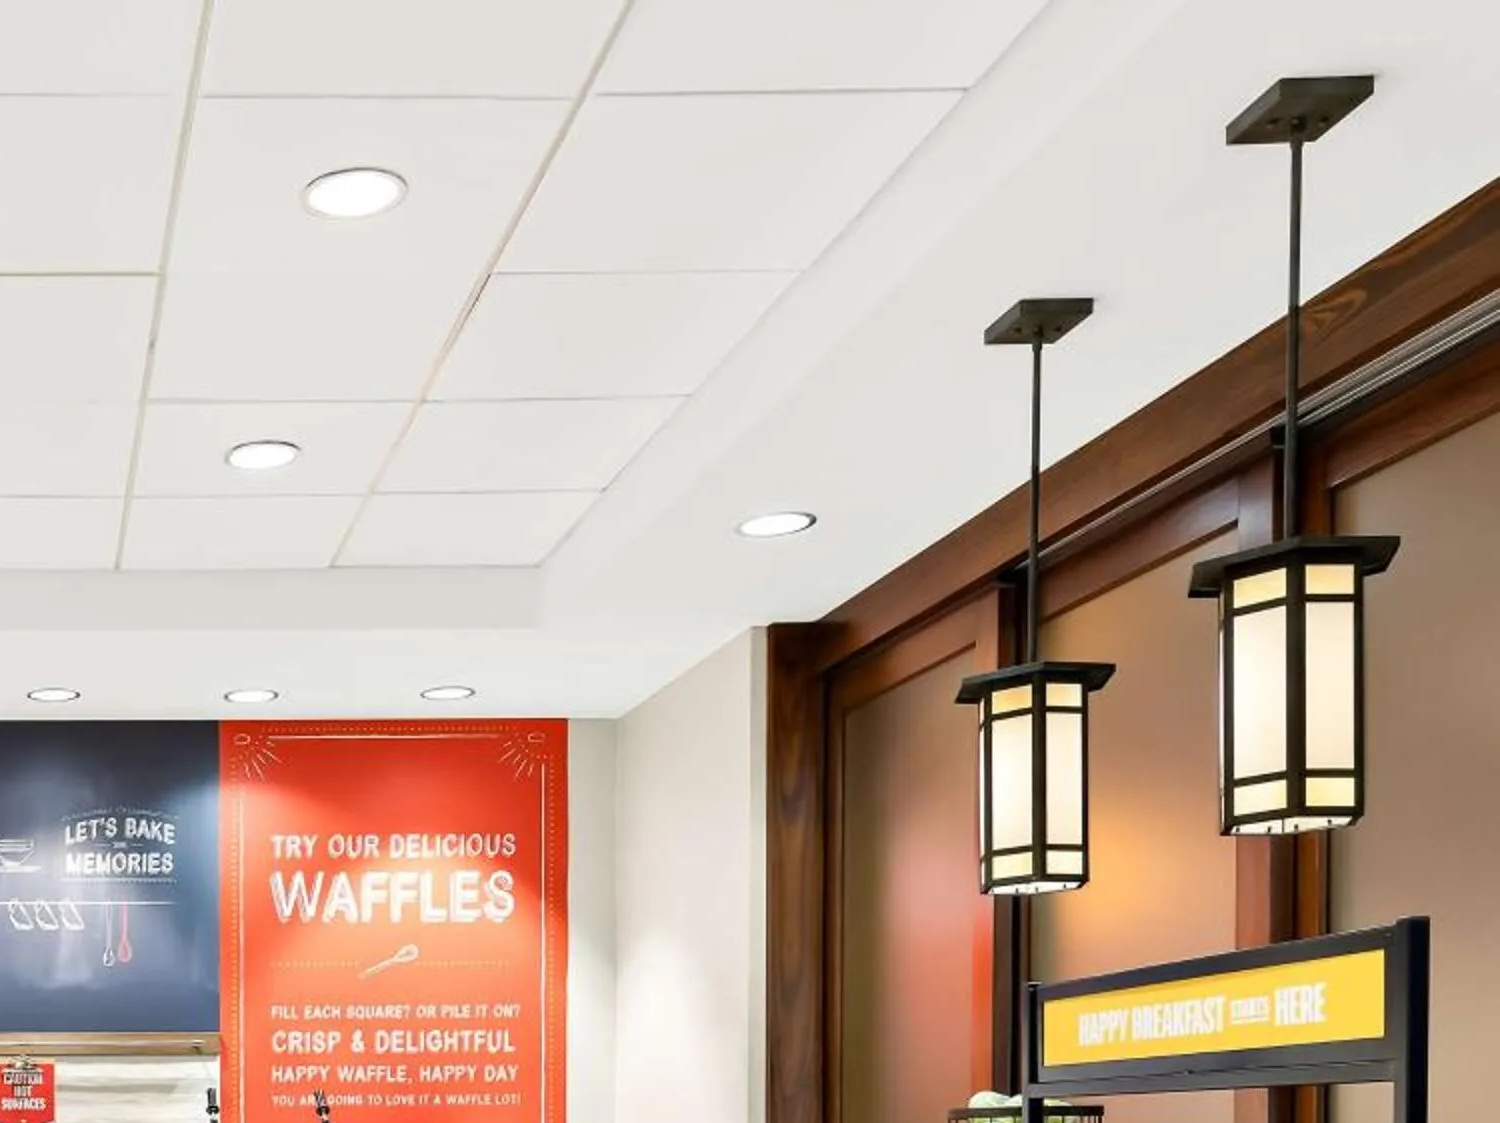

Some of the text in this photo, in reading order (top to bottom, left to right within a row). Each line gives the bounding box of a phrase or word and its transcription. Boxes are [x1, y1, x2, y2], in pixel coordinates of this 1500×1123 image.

[65, 817, 176, 846] LET'S BAKE
[271, 833, 516, 858] TRY OUR DELICIOUS
[65, 852, 174, 876] MEMORIES
[269, 869, 515, 924] WAFFLES
[271, 1003, 521, 1020] FILL EACH SQUARE? OR PILE IT ON?
[1078, 1010, 1129, 1046] HAPPY
[1131, 995, 1225, 1041] BREAKFAST
[1274, 982, 1326, 1026] HERE
[271, 1029, 516, 1054] CRISP & DELIGHTFUL
[271, 1064, 519, 1085] HAPPY WAFFLE, HAPPY DAY
[1, 1097, 47, 1111] SURFACES
[272, 1095, 295, 1107] YOU
[328, 1095, 363, 1106] GOING
[368, 1095, 383, 1106] TO
[386, 1095, 415, 1106] LOVE
[419, 1095, 430, 1105] IT
[433, 1095, 441, 1105] A
[446, 1095, 491, 1106] WAFFLE
